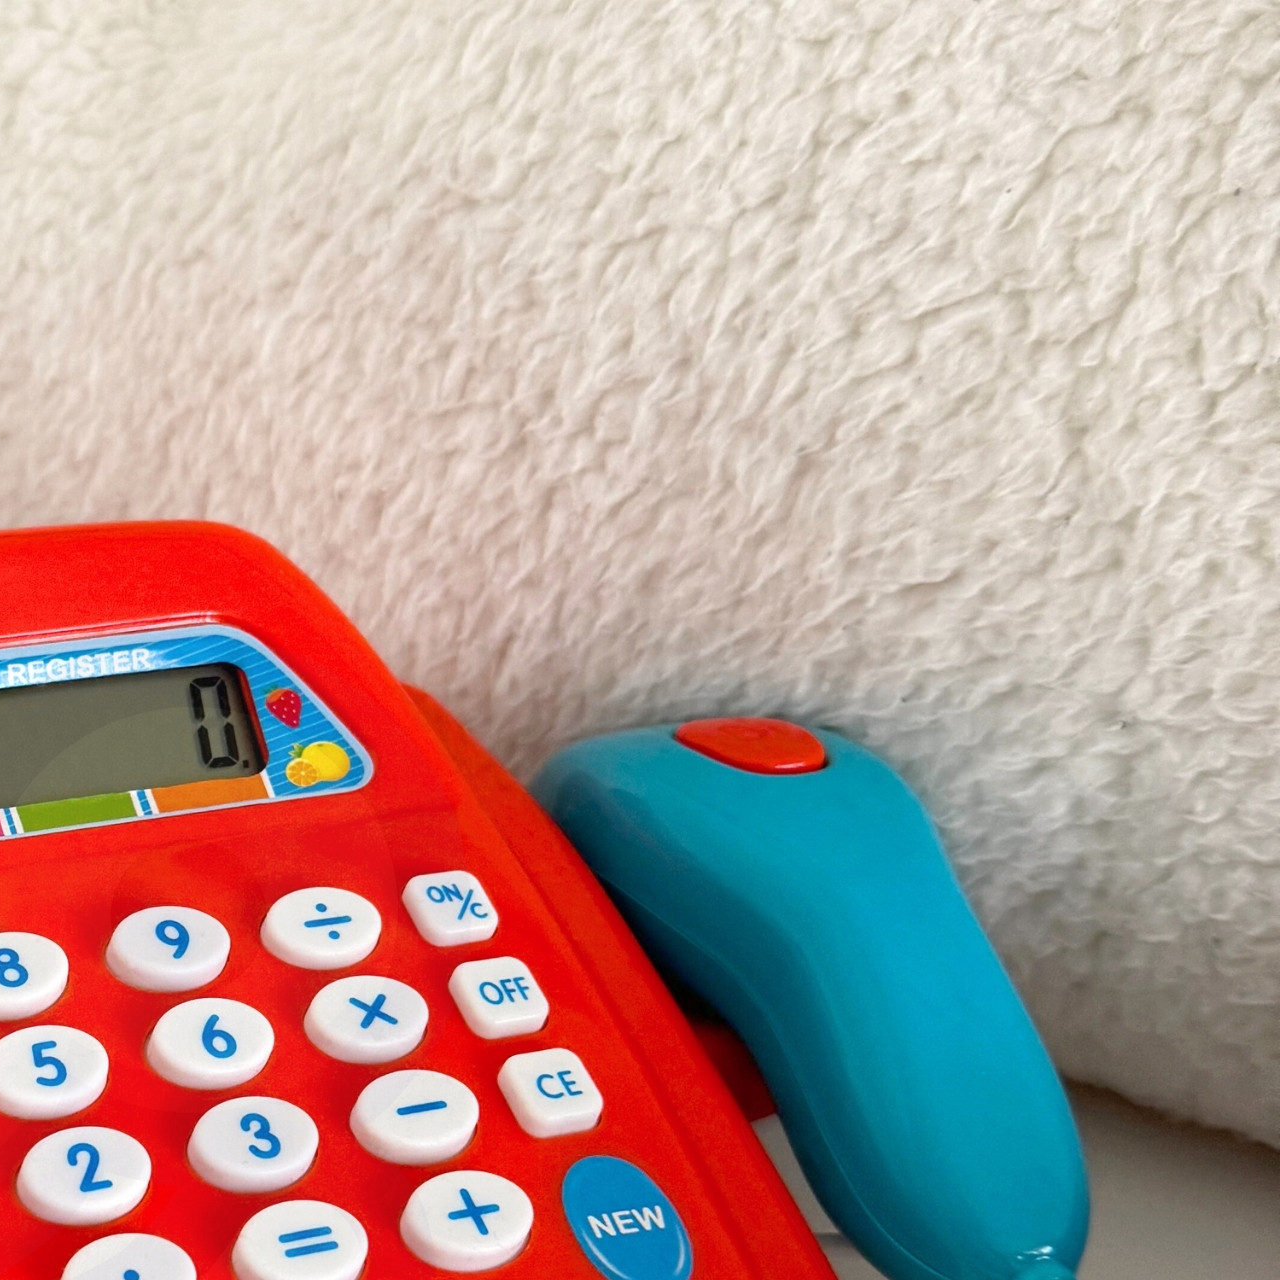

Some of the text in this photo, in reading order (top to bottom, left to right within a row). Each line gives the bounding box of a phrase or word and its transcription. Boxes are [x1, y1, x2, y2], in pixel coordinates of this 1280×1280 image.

[7, 648, 154, 686] REGISTER
[155, 919, 190, 959] 9
[479, 976, 531, 1007] OFF
[202, 1014, 238, 1059] 6
[31, 1041, 68, 1087] 5
[536, 1070, 584, 1100] CE
[239, 1113, 282, 1160] 3
[67, 1143, 113, 1193] 2
[586, 1204, 667, 1240] NEW
